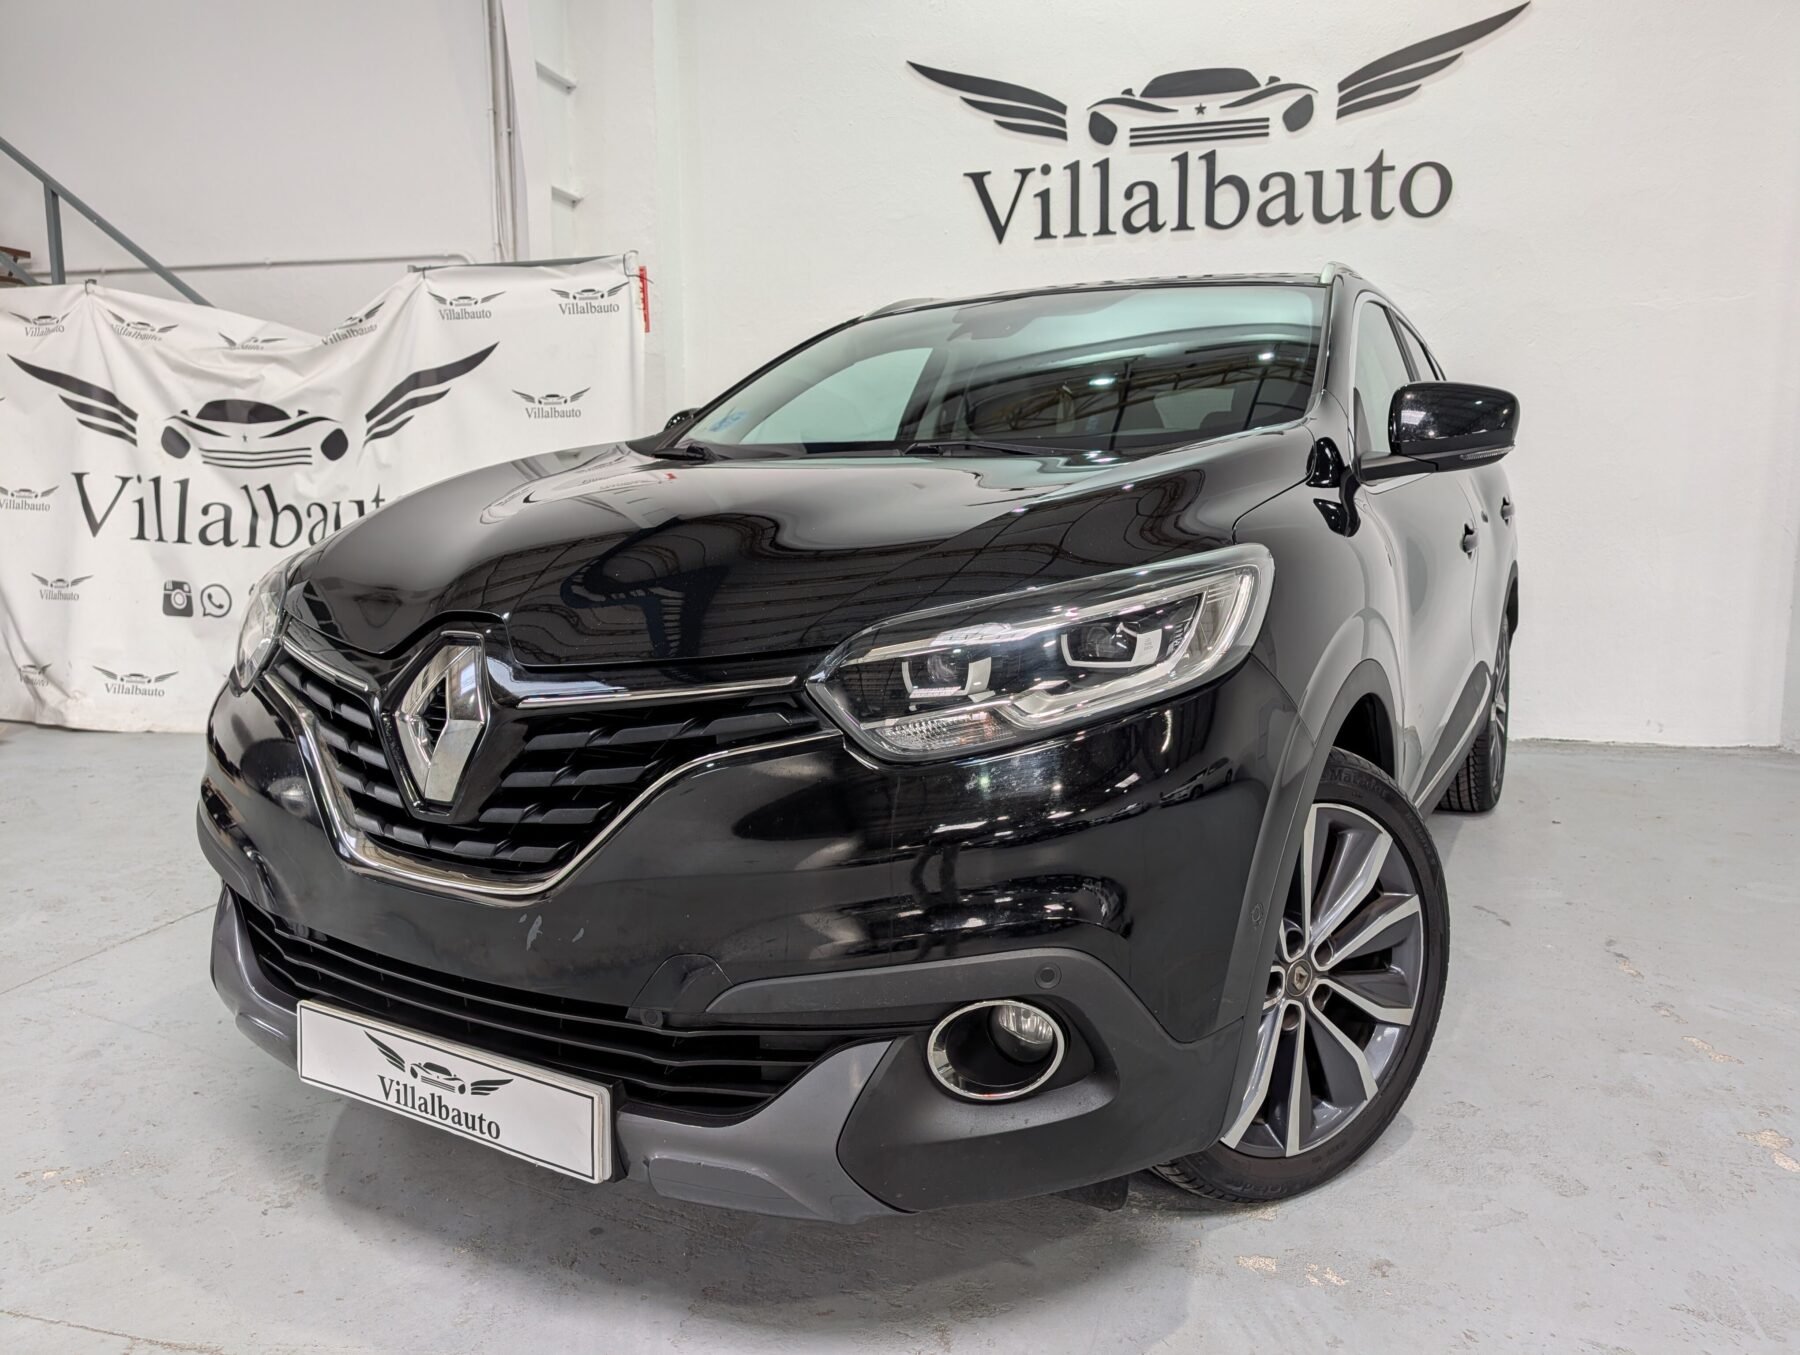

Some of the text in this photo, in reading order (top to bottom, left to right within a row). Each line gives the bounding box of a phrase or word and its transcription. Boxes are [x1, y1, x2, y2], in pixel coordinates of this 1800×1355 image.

[963, 148, 1454, 245] Villalbauto
[438, 308, 492, 320] Villalbauto
[558, 301, 620, 315] Villalbauto
[525, 407, 582, 419] Villalbauto
[104, 683, 165, 697] Villalbauto
[377, 1074, 501, 1139] Villalbauto
